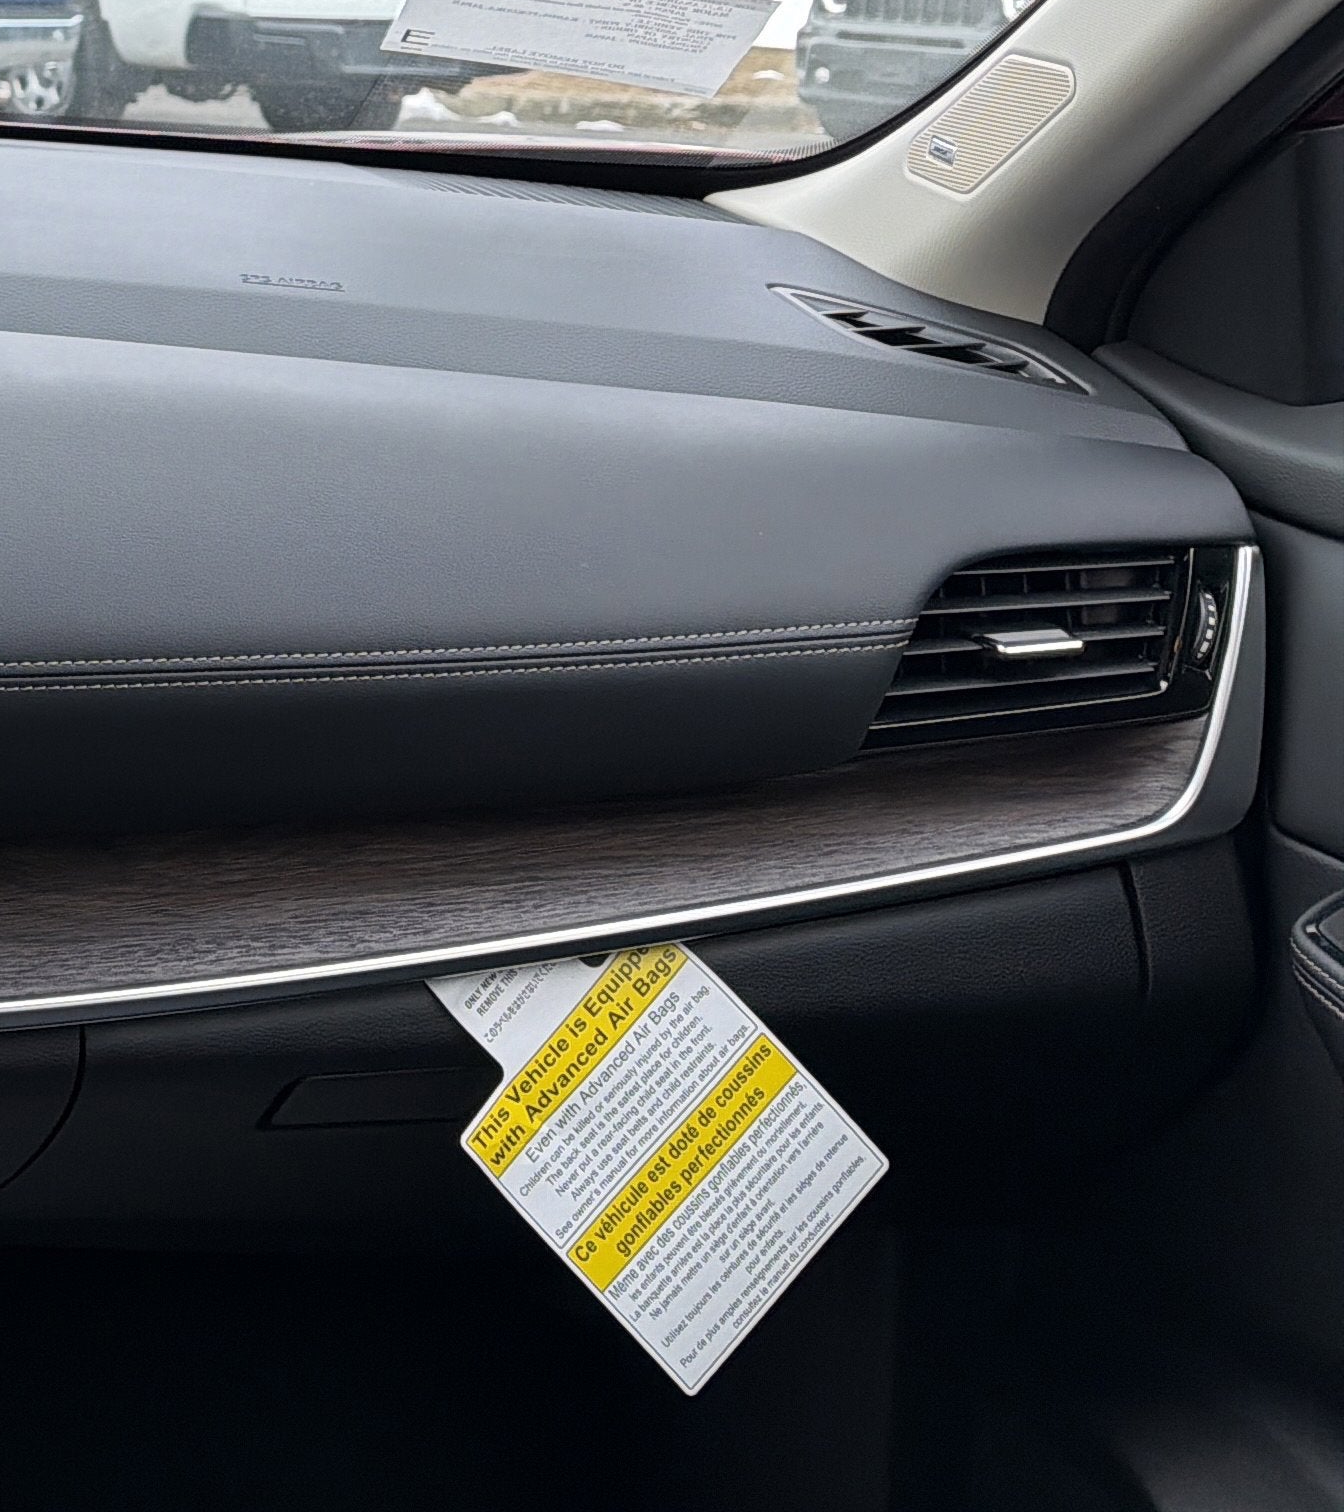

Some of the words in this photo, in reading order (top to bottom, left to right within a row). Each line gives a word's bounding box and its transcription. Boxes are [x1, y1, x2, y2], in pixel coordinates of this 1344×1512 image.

[464, 987, 483, 1010] ONLY
[476, 984, 505, 1016] REMOVE
[500, 969, 518, 987] THIS
[489, 1124, 526, 1165] with
[524, 1026, 608, 1123] Advanced
[607, 996, 634, 1031] Air
[631, 948, 678, 998] Bags
[524, 1127, 557, 1164] Even
[553, 1101, 582, 1129] with
[578, 1039, 636, 1106] Advanced
[631, 1021, 652, 1046] Air
[646, 990, 680, 1026] Bags
[470, 1106, 510, 1149] This
[504, 1037, 569, 1103] Vehicle
[564, 1016, 587, 1038] is
[519, 1161, 551, 1196] Children
[549, 1144, 565, 1162] can
[561, 1133, 575, 1146] be
[572, 1109, 595, 1134] killed
[594, 1101, 604, 1113] or
[603, 1066, 637, 1103] seriously
[634, 1037, 662, 1068] injured
[658, 1027, 672, 1040] by
[668, 1013, 684, 1029] the
[682, 1001, 693, 1015] air
[691, 985, 710, 1003] bag.
[544, 1168, 563, 1185] The
[560, 1147, 581, 1169] back
[579, 1127, 598, 1148] seat
[594, 1120, 605, 1130] is
[602, 1106, 618, 1122] the
[617, 1081, 642, 1108] safest
[640, 1059, 662, 1085] place
[659, 1046, 672, 1061] for
[671, 1016, 703, 1048] children.
[575, 1240, 597, 1261] Ce
[594, 1181, 648, 1239] véhicule
[647, 1155, 671, 1182] est
[668, 1123, 699, 1159] doté
[697, 1106, 716, 1127] de
[715, 1044, 770, 1107] coussins
[608, 1268, 638, 1300] Même
[636, 1245, 659, 1271] avec
[656, 1227, 675, 1248] des
[672, 1188, 710, 1229] coussins
[707, 1142, 750, 1193] gonflables
[748, 1081, 806, 1146] perfectionnés,
[616, 1181, 681, 1256] gonflables
[680, 1087, 764, 1185] perfectionnés
